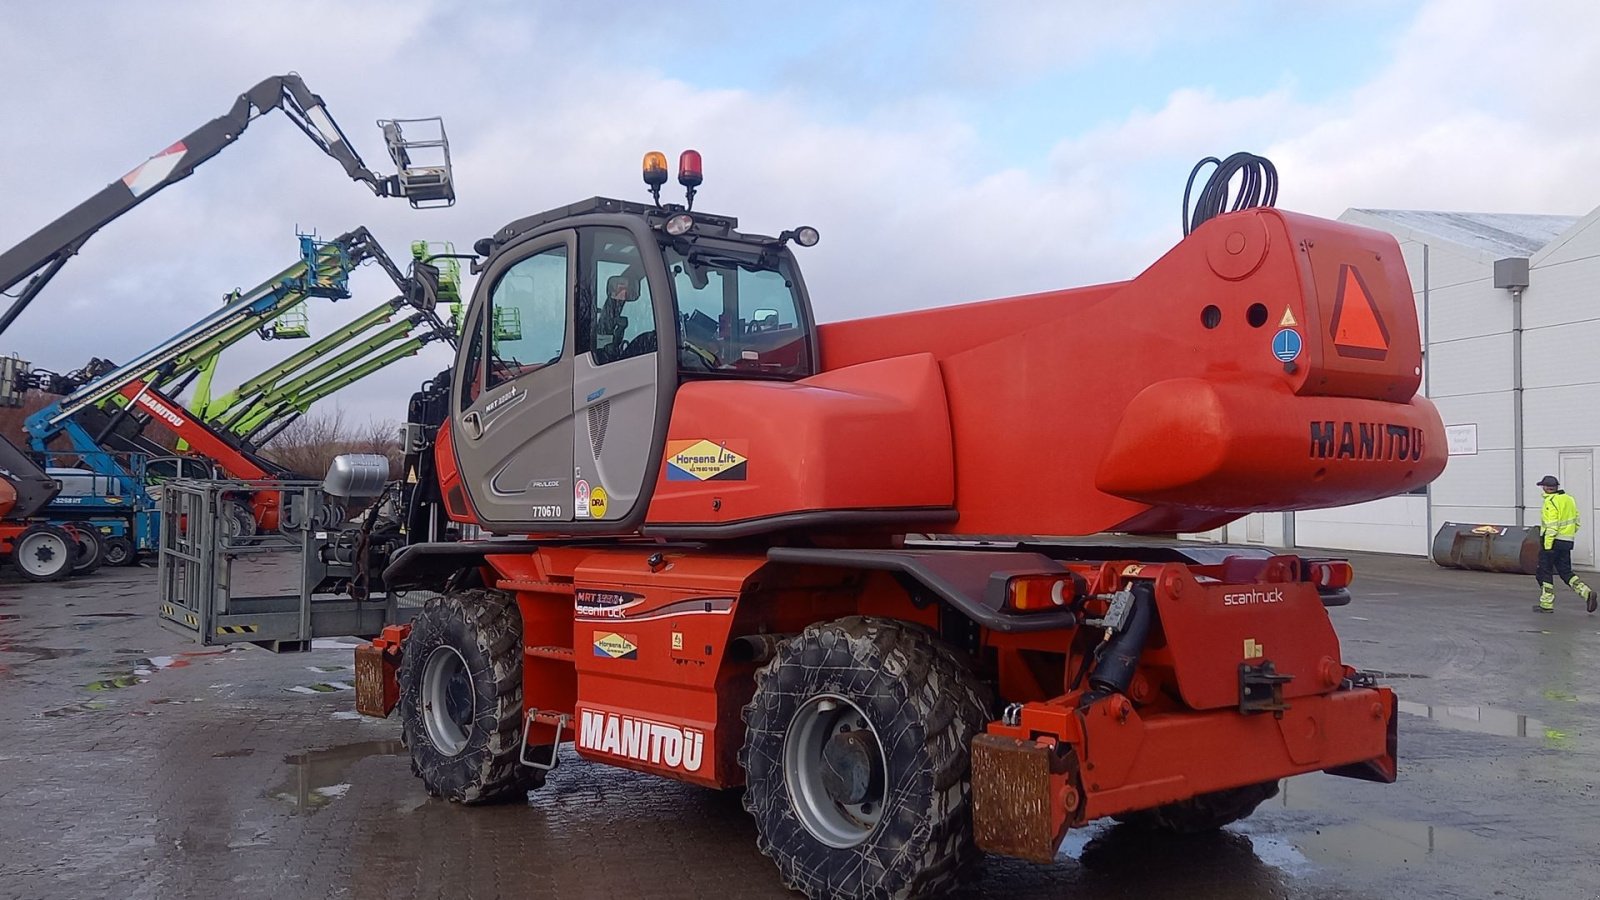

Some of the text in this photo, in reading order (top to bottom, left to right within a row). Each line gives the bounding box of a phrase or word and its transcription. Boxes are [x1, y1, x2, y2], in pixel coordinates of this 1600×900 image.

[139, 393, 184, 427] MANITOU
[1310, 420, 1425, 462] MANITOU
[676, 441, 736, 464] Horsens Lift
[532, 505, 561, 518] 770670
[591, 499, 605, 507] DRA
[577, 592, 597, 603] MRT
[1224, 587, 1284, 606] scantruck
[577, 603, 626, 619] scantruck
[579, 711, 704, 771] MANITOU
